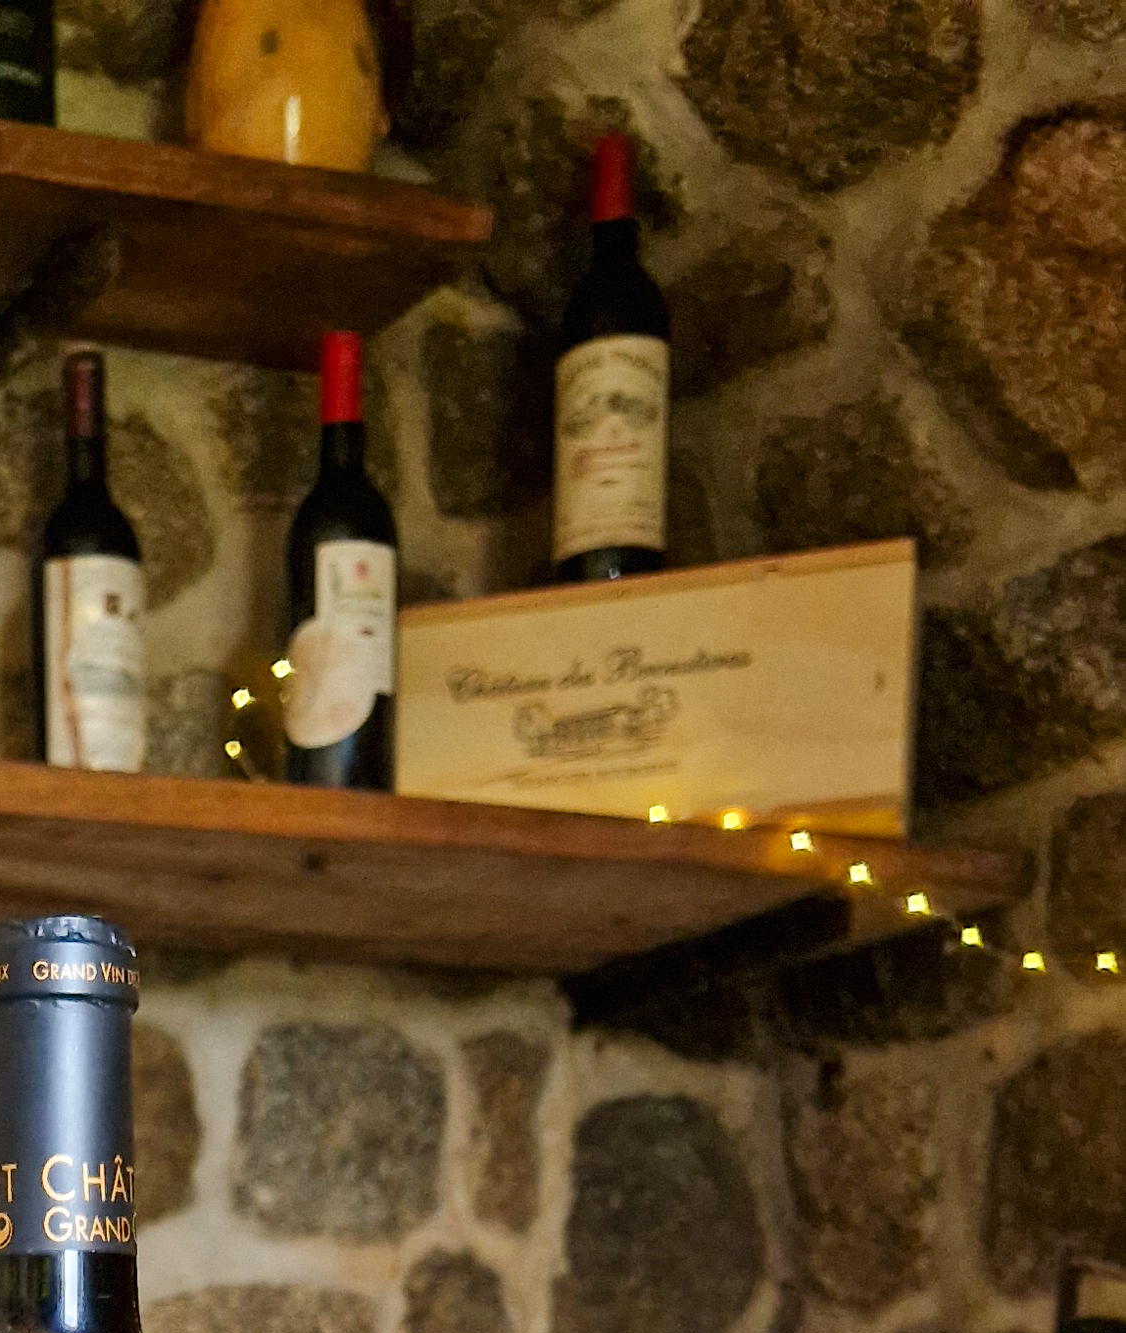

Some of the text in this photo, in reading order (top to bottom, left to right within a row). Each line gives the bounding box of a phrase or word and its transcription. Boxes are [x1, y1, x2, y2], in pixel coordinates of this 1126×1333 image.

[32, 960, 98, 982] GRAND
[100, 961, 125, 984] VIN
[41, 1153, 135, 1203] CHÂT
[43, 1206, 131, 1243] GRAND
